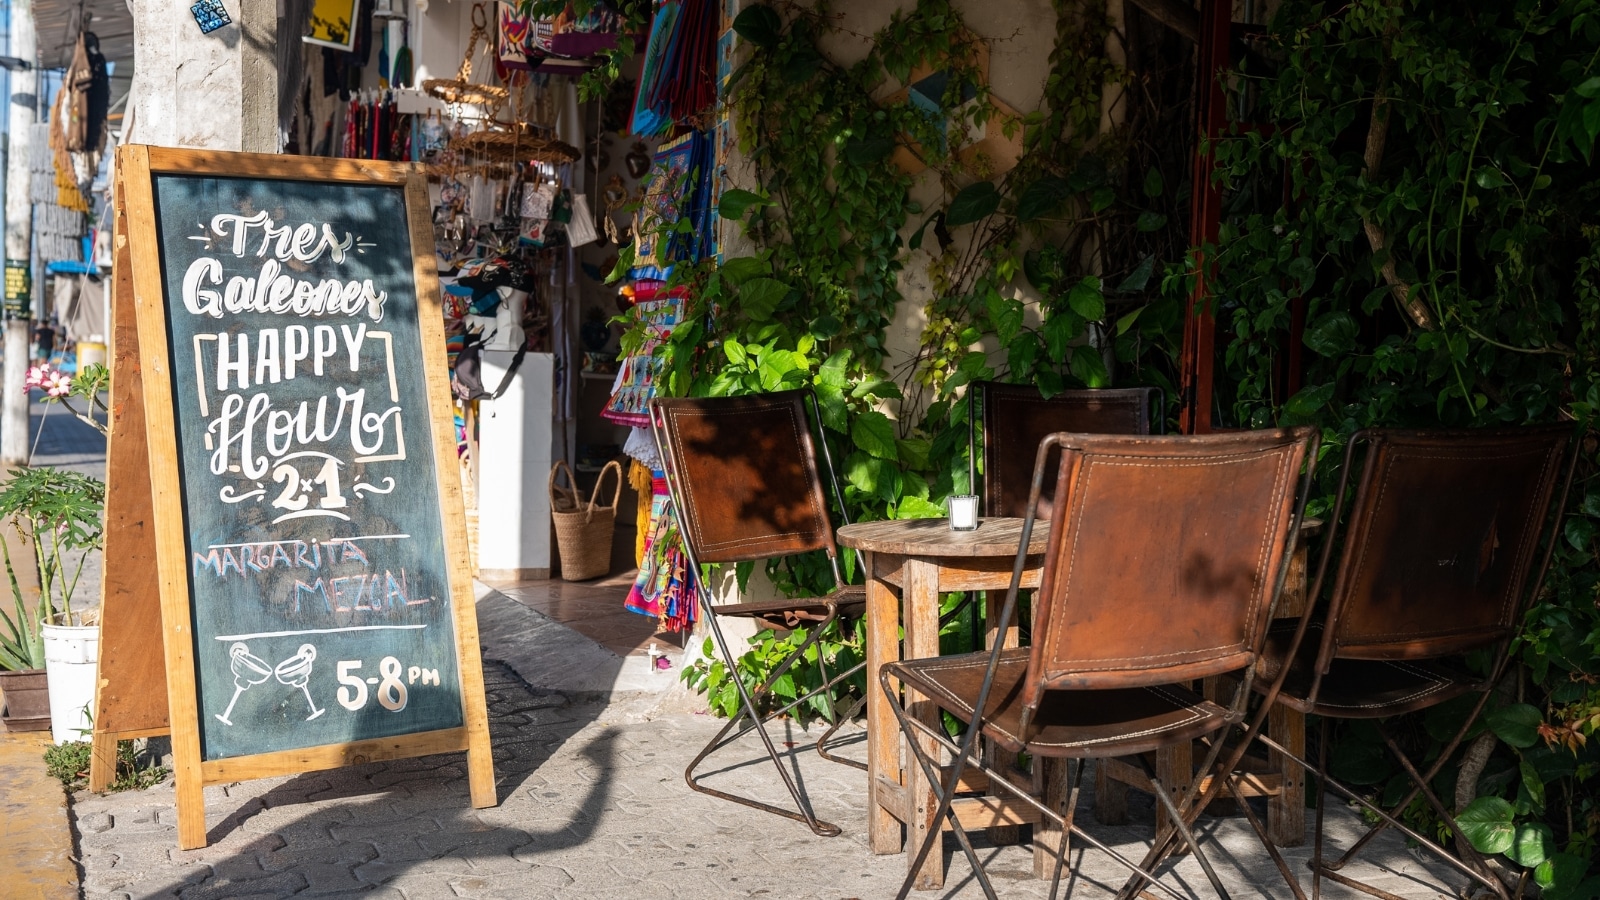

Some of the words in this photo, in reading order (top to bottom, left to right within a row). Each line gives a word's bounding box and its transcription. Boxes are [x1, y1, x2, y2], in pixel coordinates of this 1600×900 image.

[211, 210, 353, 264] Tres
[182, 257, 387, 322] Galeones
[217, 323, 367, 392] HAPPY
[207, 387, 402, 480] Hour
[294, 569, 430, 612] MEZCAL
[336, 656, 408, 712] 5-8
[408, 665, 440, 687] PM
